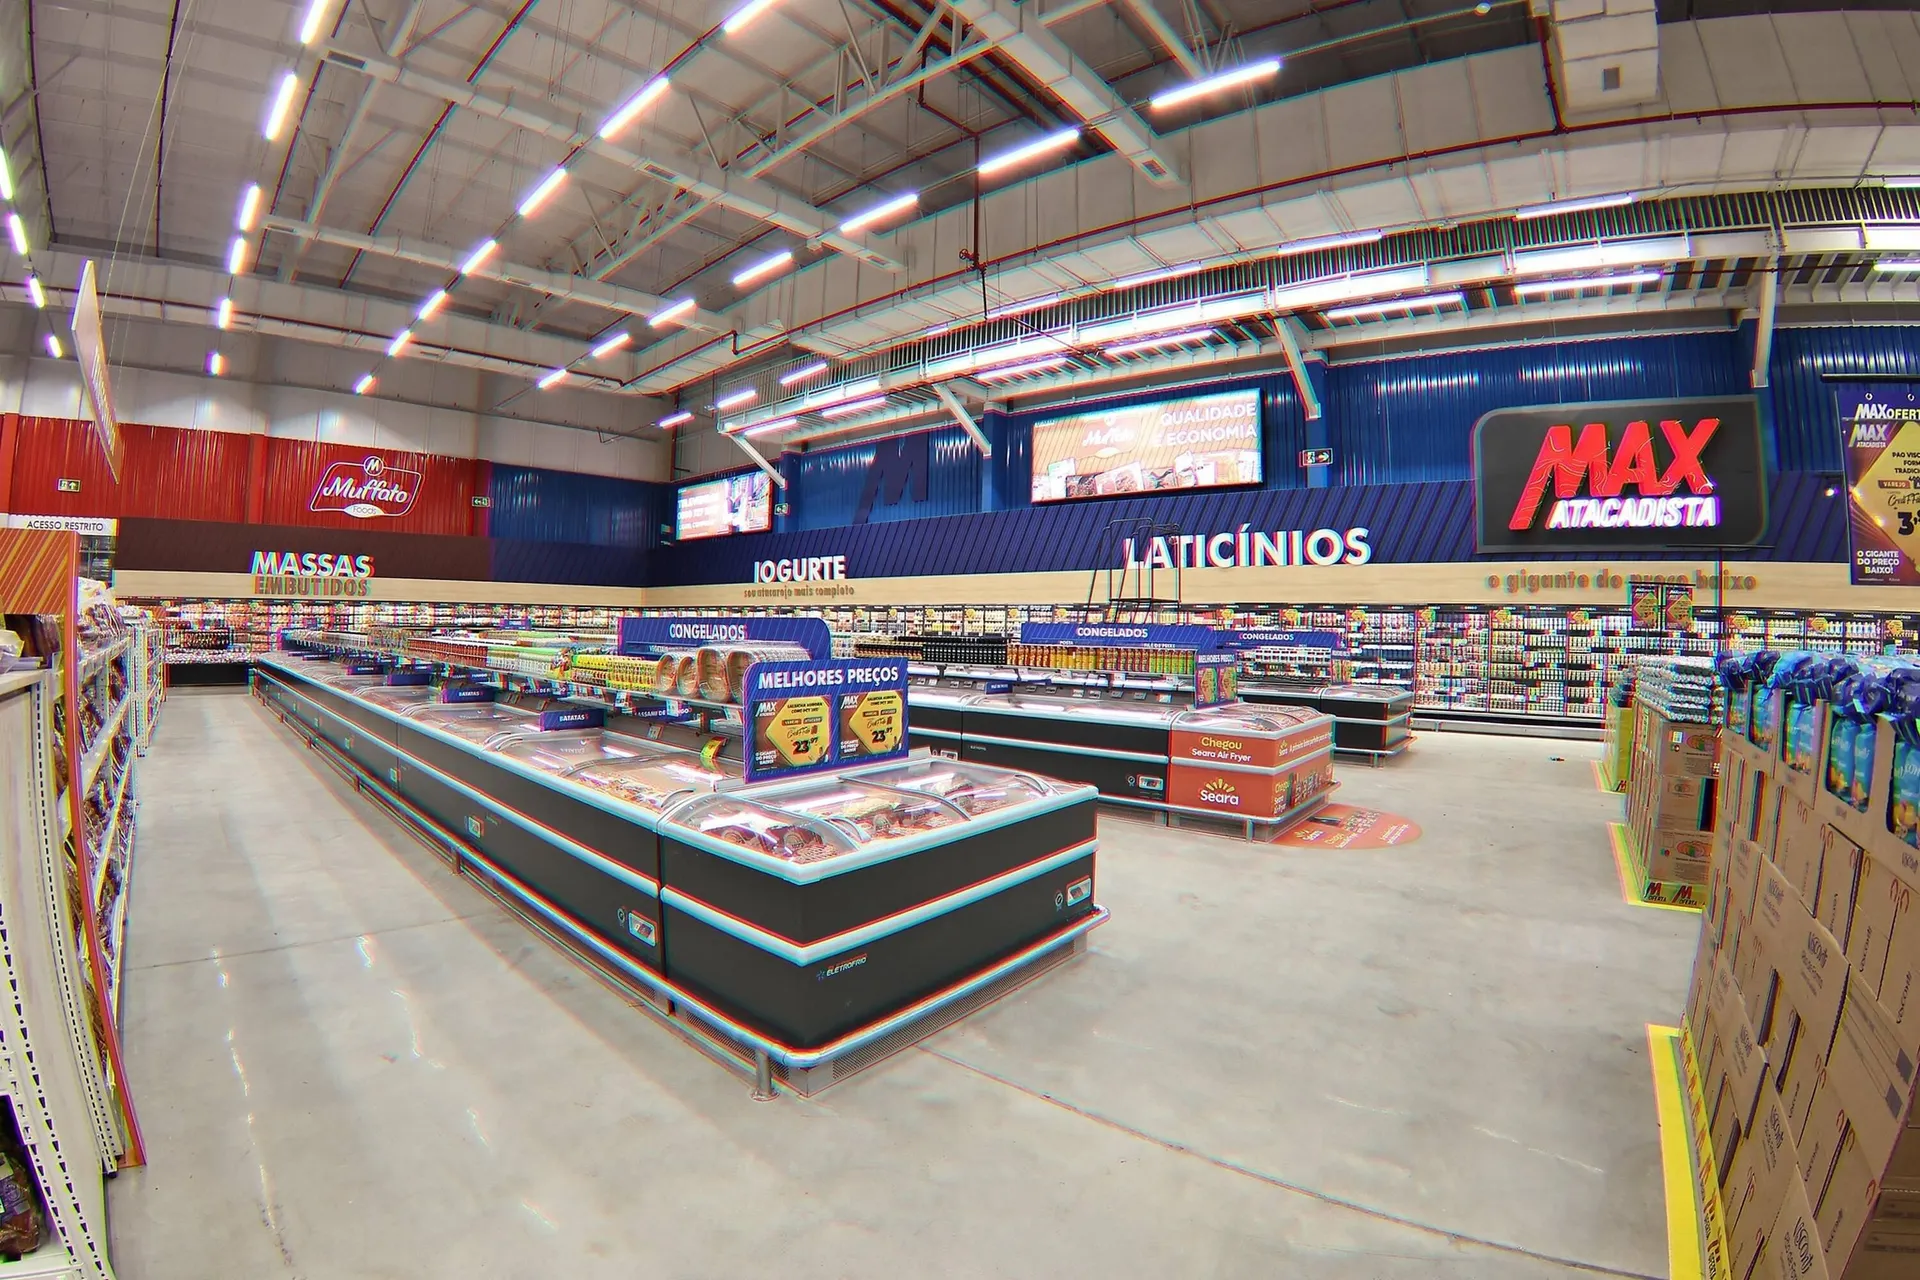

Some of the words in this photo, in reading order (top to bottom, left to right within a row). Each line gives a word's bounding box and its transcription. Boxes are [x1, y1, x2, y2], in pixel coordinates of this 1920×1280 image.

[1161, 402, 1257, 427] QUALIDADE
[1166, 424, 1258, 446] ECONOMIA
[1848, 424, 1887, 448] MAX
[366, 458, 380, 472] M
[1509, 417, 1721, 531] MAX
[322, 476, 408, 503] Muffato
[1545, 496, 1720, 531] ATACADISTA
[27, 520, 62, 530] ACESSO
[64, 522, 104, 532] RESTRITO
[1123, 523, 1372, 568] LATICÍNIOS
[250, 551, 375, 577] MASSAS
[754, 555, 846, 584] IOGURTE
[1865, 566, 1894, 574] BAIXO!
[253, 577, 371, 597] EMBUTIDOS
[1487, 574, 1501, 589] o
[1506, 569, 1590, 594] gigante
[1596, 569, 1624, 589] do
[1695, 569, 1757, 590] baixo
[794, 584, 814, 597] mais
[815, 583, 855, 599] completo
[669, 623, 747, 641] CONGELADOS
[1076, 627, 1149, 638] CONGELADOS
[1240, 633, 1295, 641] CONGELADOS
[1198, 654, 1220, 663] MELHORES
[758, 670, 843, 690] MELHORES
[847, 666, 899, 687] PREÇOS
[755, 702, 777, 717] MAX
[841, 695, 859, 709] MAX
[559, 714, 586, 722] BATATAS
[1201, 736, 1243, 750] Chegou
[1192, 748, 1216, 758] Seara
[1217, 751, 1229, 760] Air
[1230, 752, 1251, 763] Fryer
[1200, 789, 1239, 806] Seara
[826, 956, 867, 977] ELETROFRIO
